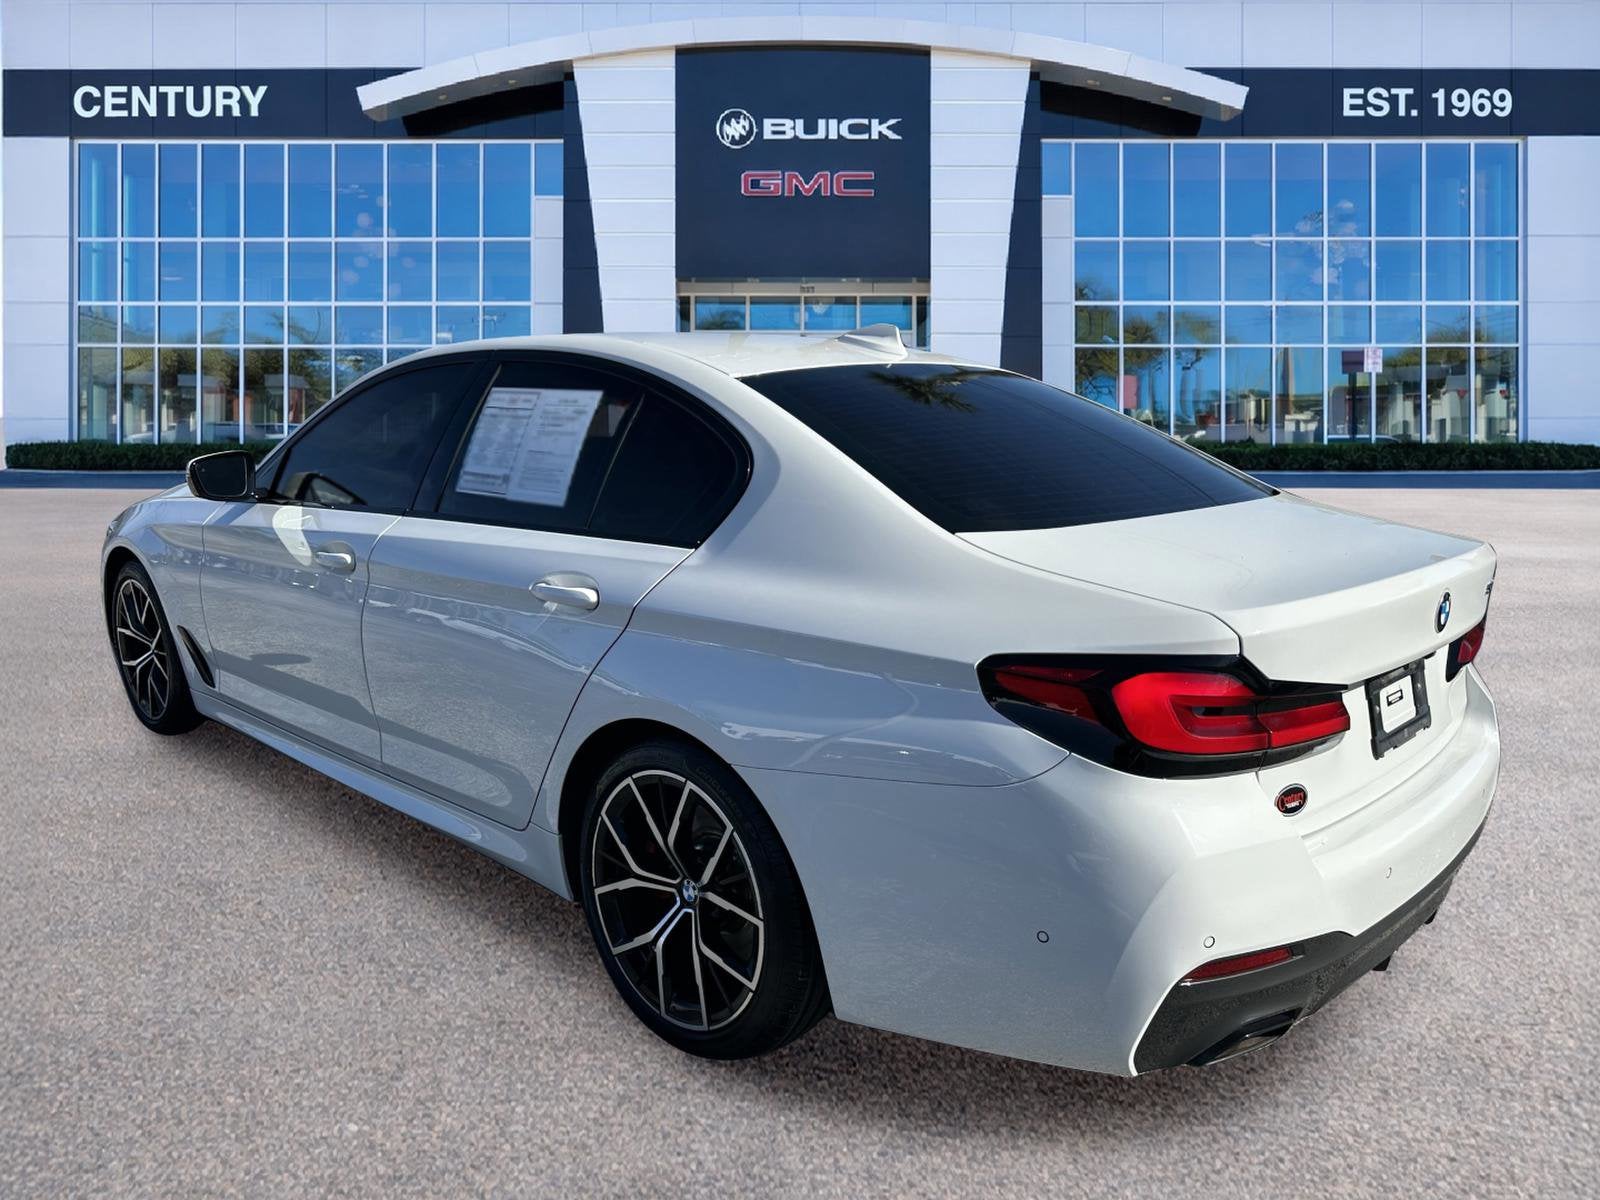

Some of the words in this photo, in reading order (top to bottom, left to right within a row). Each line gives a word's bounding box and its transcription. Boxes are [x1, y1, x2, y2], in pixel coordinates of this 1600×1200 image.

[73, 85, 268, 118] CENTURY
[1342, 87, 1418, 117] EST.
[1432, 88, 1513, 117] 1969
[763, 118, 903, 140] BUICK
[741, 170, 875, 197] GMC
